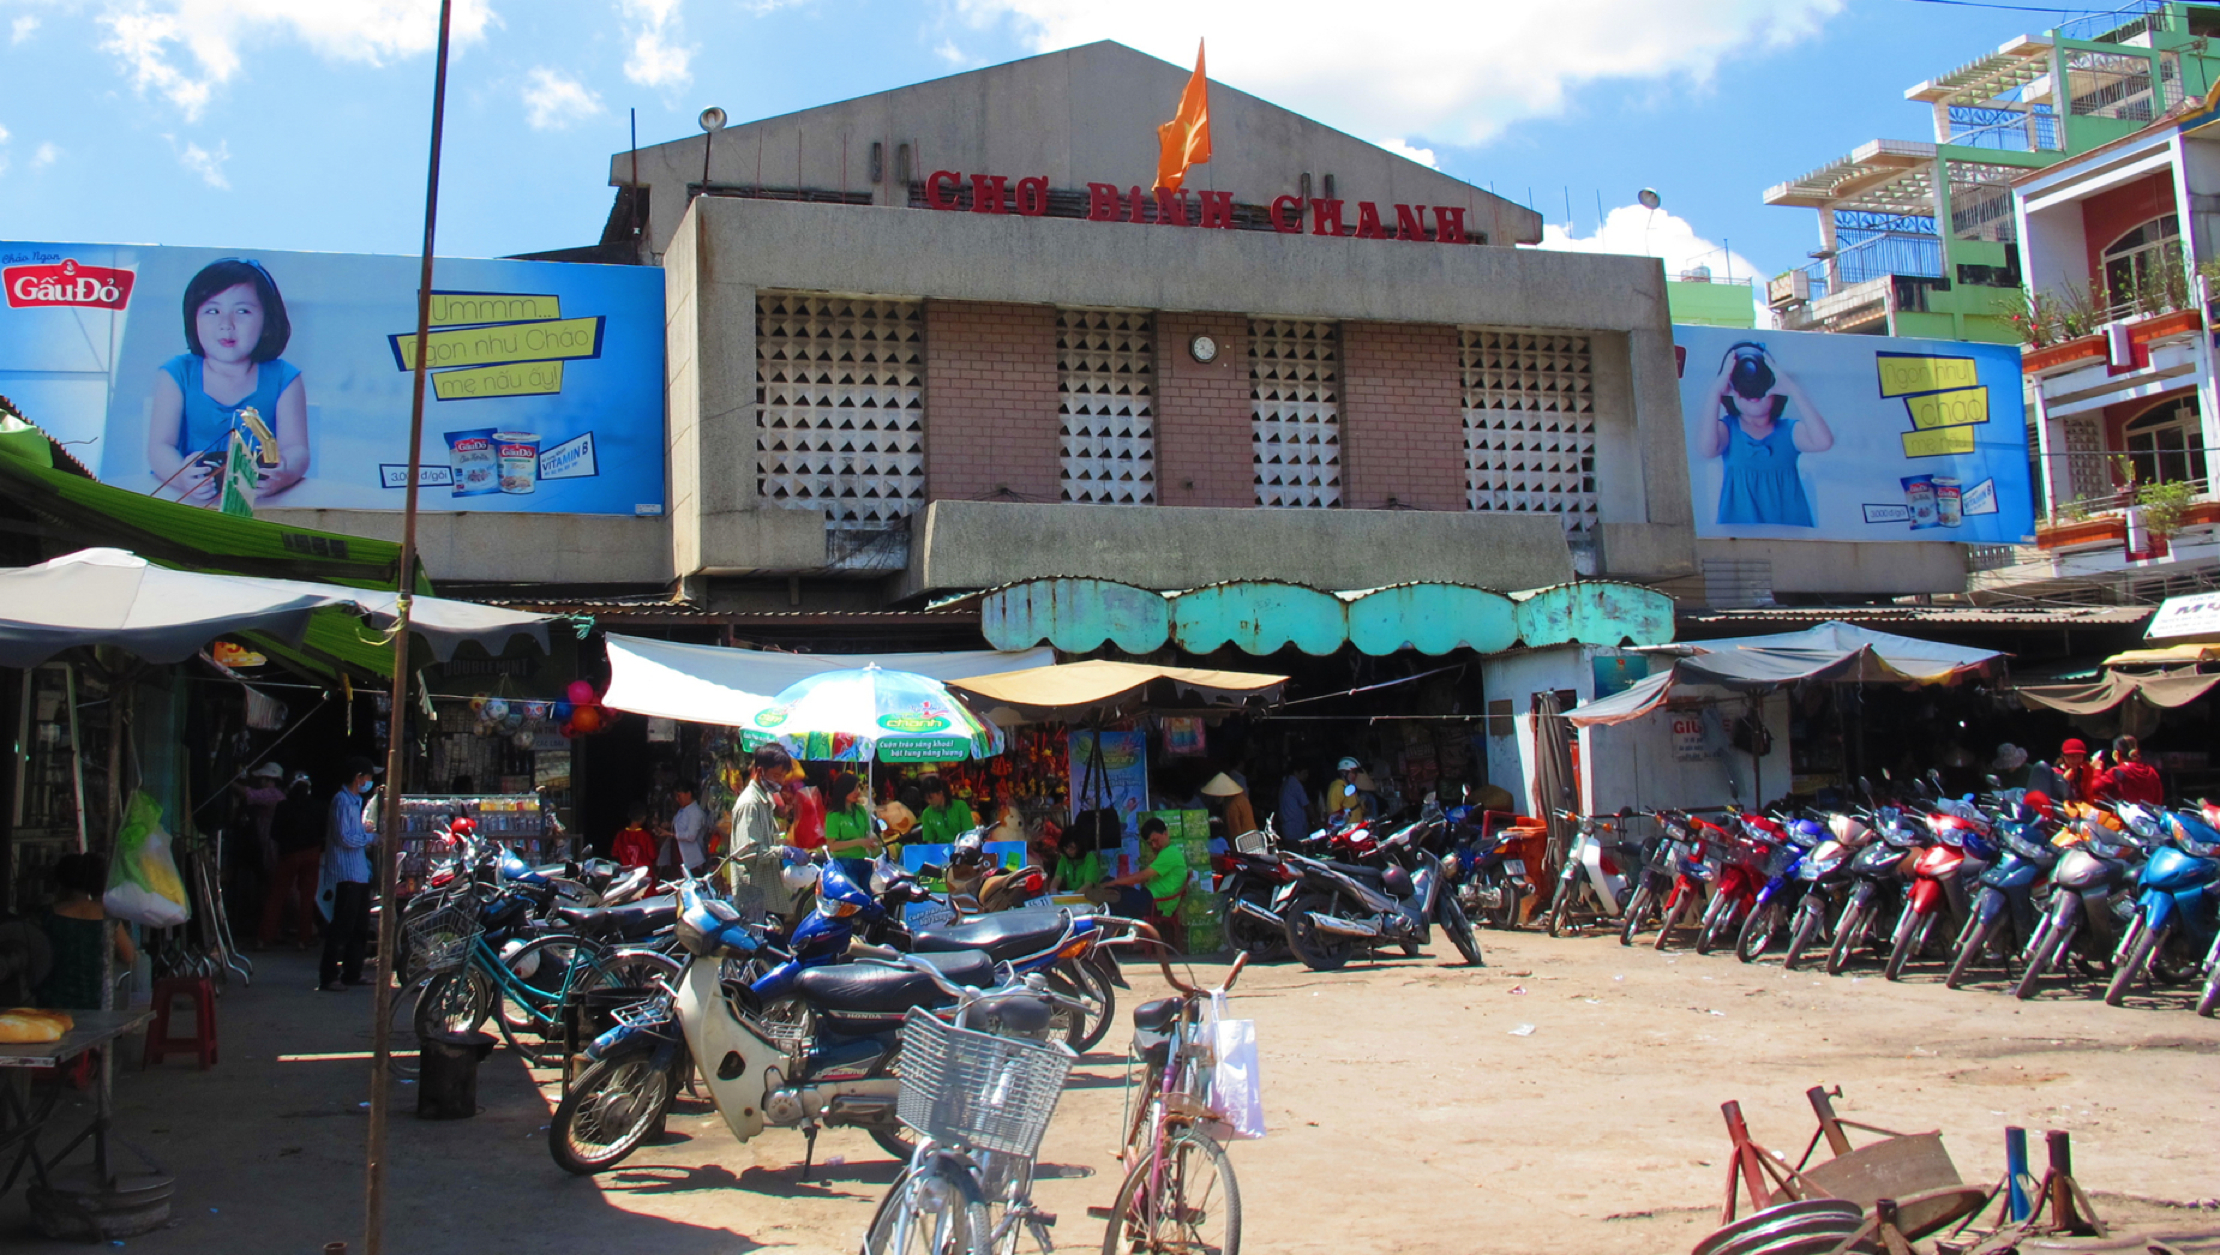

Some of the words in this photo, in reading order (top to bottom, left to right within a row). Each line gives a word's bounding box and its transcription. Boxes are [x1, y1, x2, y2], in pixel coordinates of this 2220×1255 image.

[1270, 194, 1469, 245] CHANH
[542, 445, 580, 471] VITAMIN
[582, 441, 589, 456] B
[847, 1012, 882, 1020] HONDA
